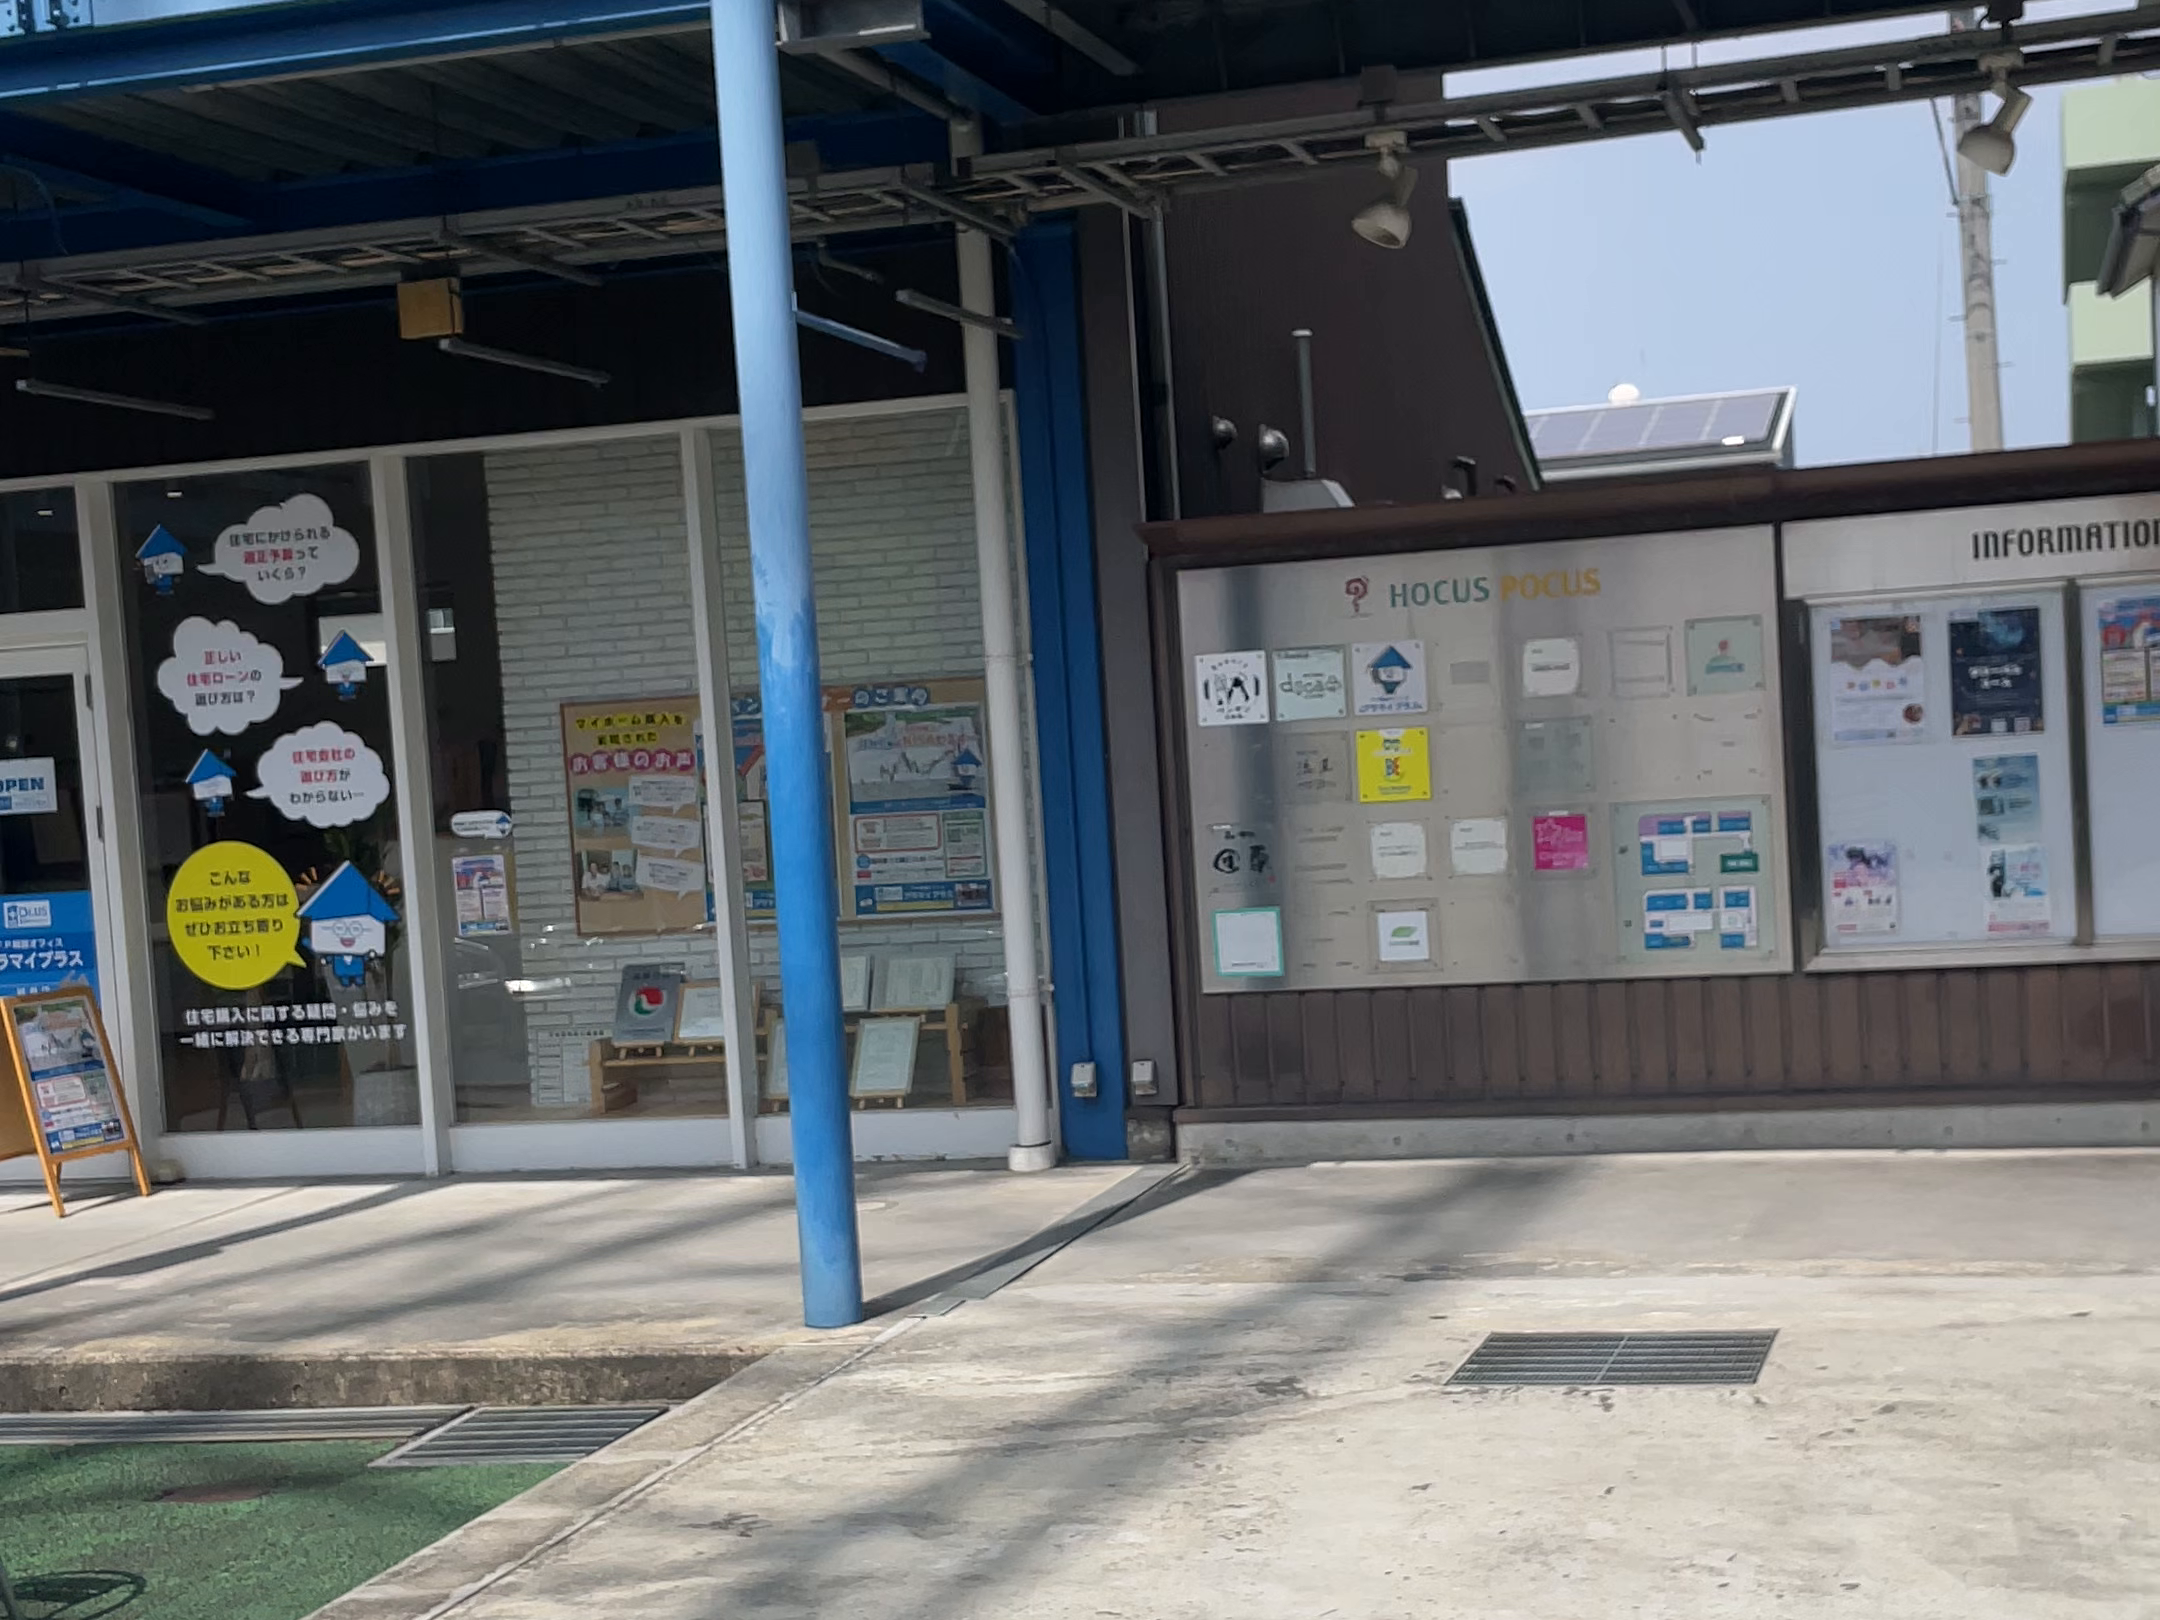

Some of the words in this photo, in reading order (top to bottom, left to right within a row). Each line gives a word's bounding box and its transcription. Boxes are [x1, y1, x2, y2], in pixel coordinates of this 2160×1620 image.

[1389, 577, 1490, 608] HOCUS
[1501, 567, 1602, 602] POCUS
[204, 650, 242, 665] 正しい
[186, 669, 262, 687] 住宅ローンの
[292, 747, 356, 764] 住宅会社の
[300, 768, 351, 784] 選び方が
[209, 870, 251, 886] こんな
[175, 893, 289, 913] お悩みがある方は
[185, 917, 284, 937] ぜひお立ち寄り
[184, 1000, 398, 1026] 住宅購入に関する疑問・悩みを
[179, 1024, 407, 1049] 一緒に解決できる専門家がいます
